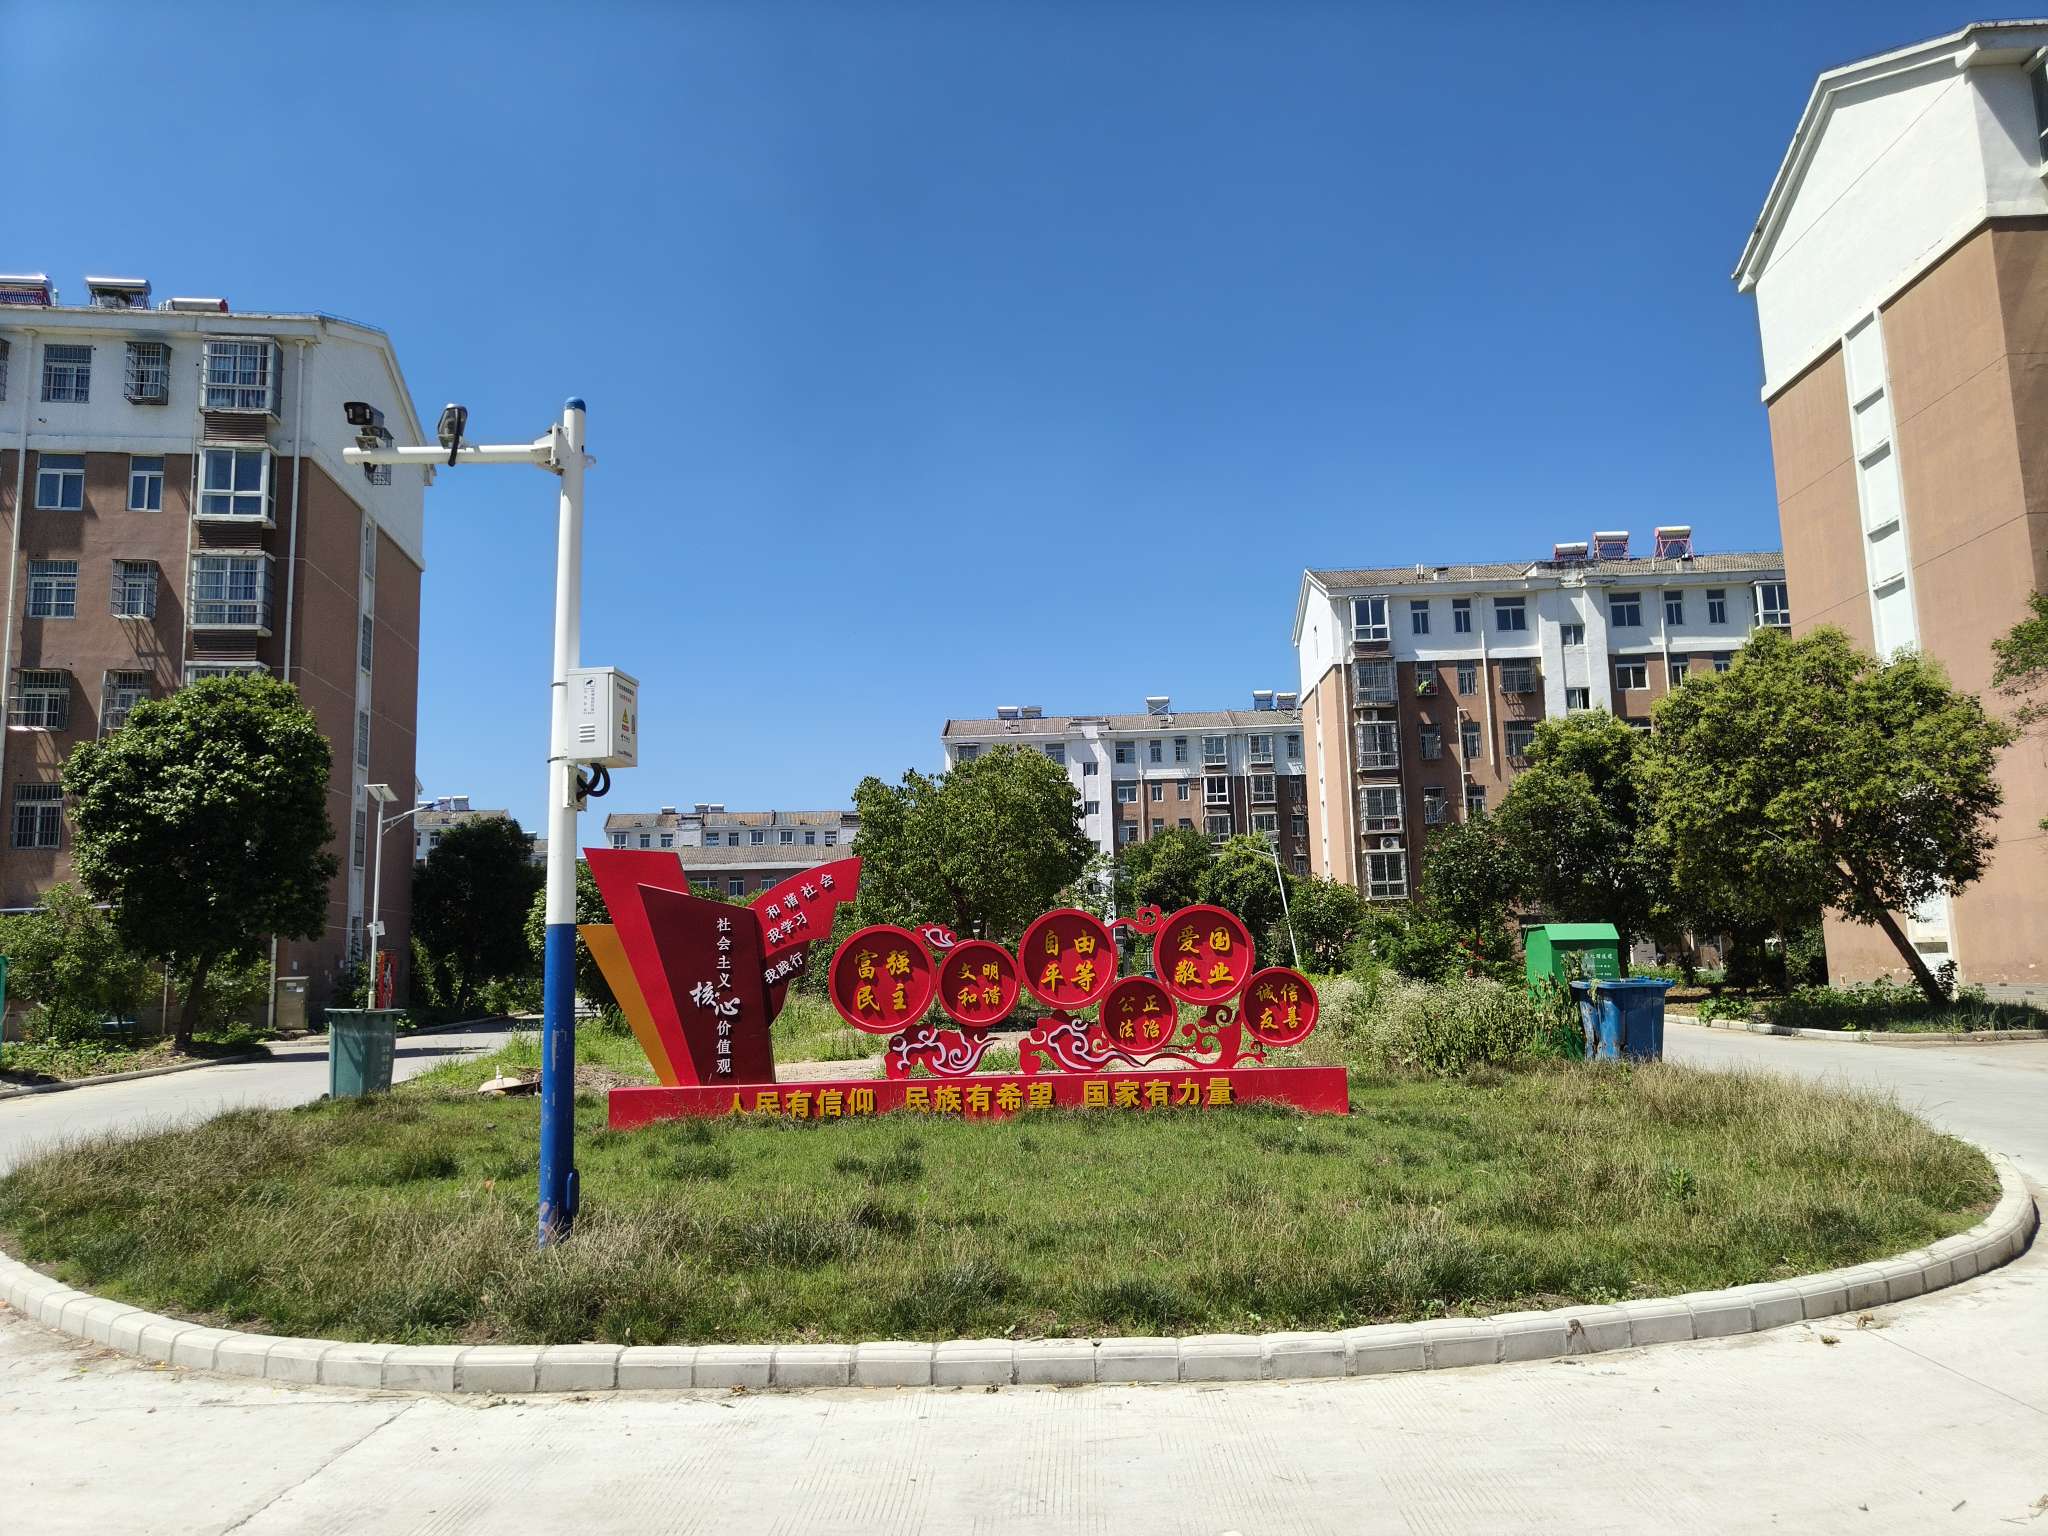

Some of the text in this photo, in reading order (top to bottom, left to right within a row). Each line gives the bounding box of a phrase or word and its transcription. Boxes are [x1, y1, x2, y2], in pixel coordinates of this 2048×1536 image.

[765, 873, 834, 919] 和谐社会
[766, 911, 807, 944] 我学习
[1045, 928, 1096, 956] 自由
[1177, 925, 1231, 954] 爱国
[716, 917, 732, 988] 社会主义
[764, 952, 804, 984] 我践行
[855, 949, 911, 980] 富强
[958, 961, 999, 982] 文明
[1040, 960, 1096, 993] 平等
[1175, 960, 1235, 985] 敬业
[689, 981, 741, 1016] 核心
[857, 983, 908, 1012] 民主
[957, 987, 1001, 1007] 和谐
[1118, 994, 1160, 1013] 公正
[1256, 983, 1299, 1003] 诚信
[1119, 1020, 1160, 1039] 法治
[1259, 1005, 1302, 1031] 友善
[716, 1020, 732, 1073] 价值观
[729, 1087, 874, 1119] 人民有信仰
[906, 1082, 1053, 1113] 民族有希望
[1083, 1077, 1234, 1108] 国家有力量
